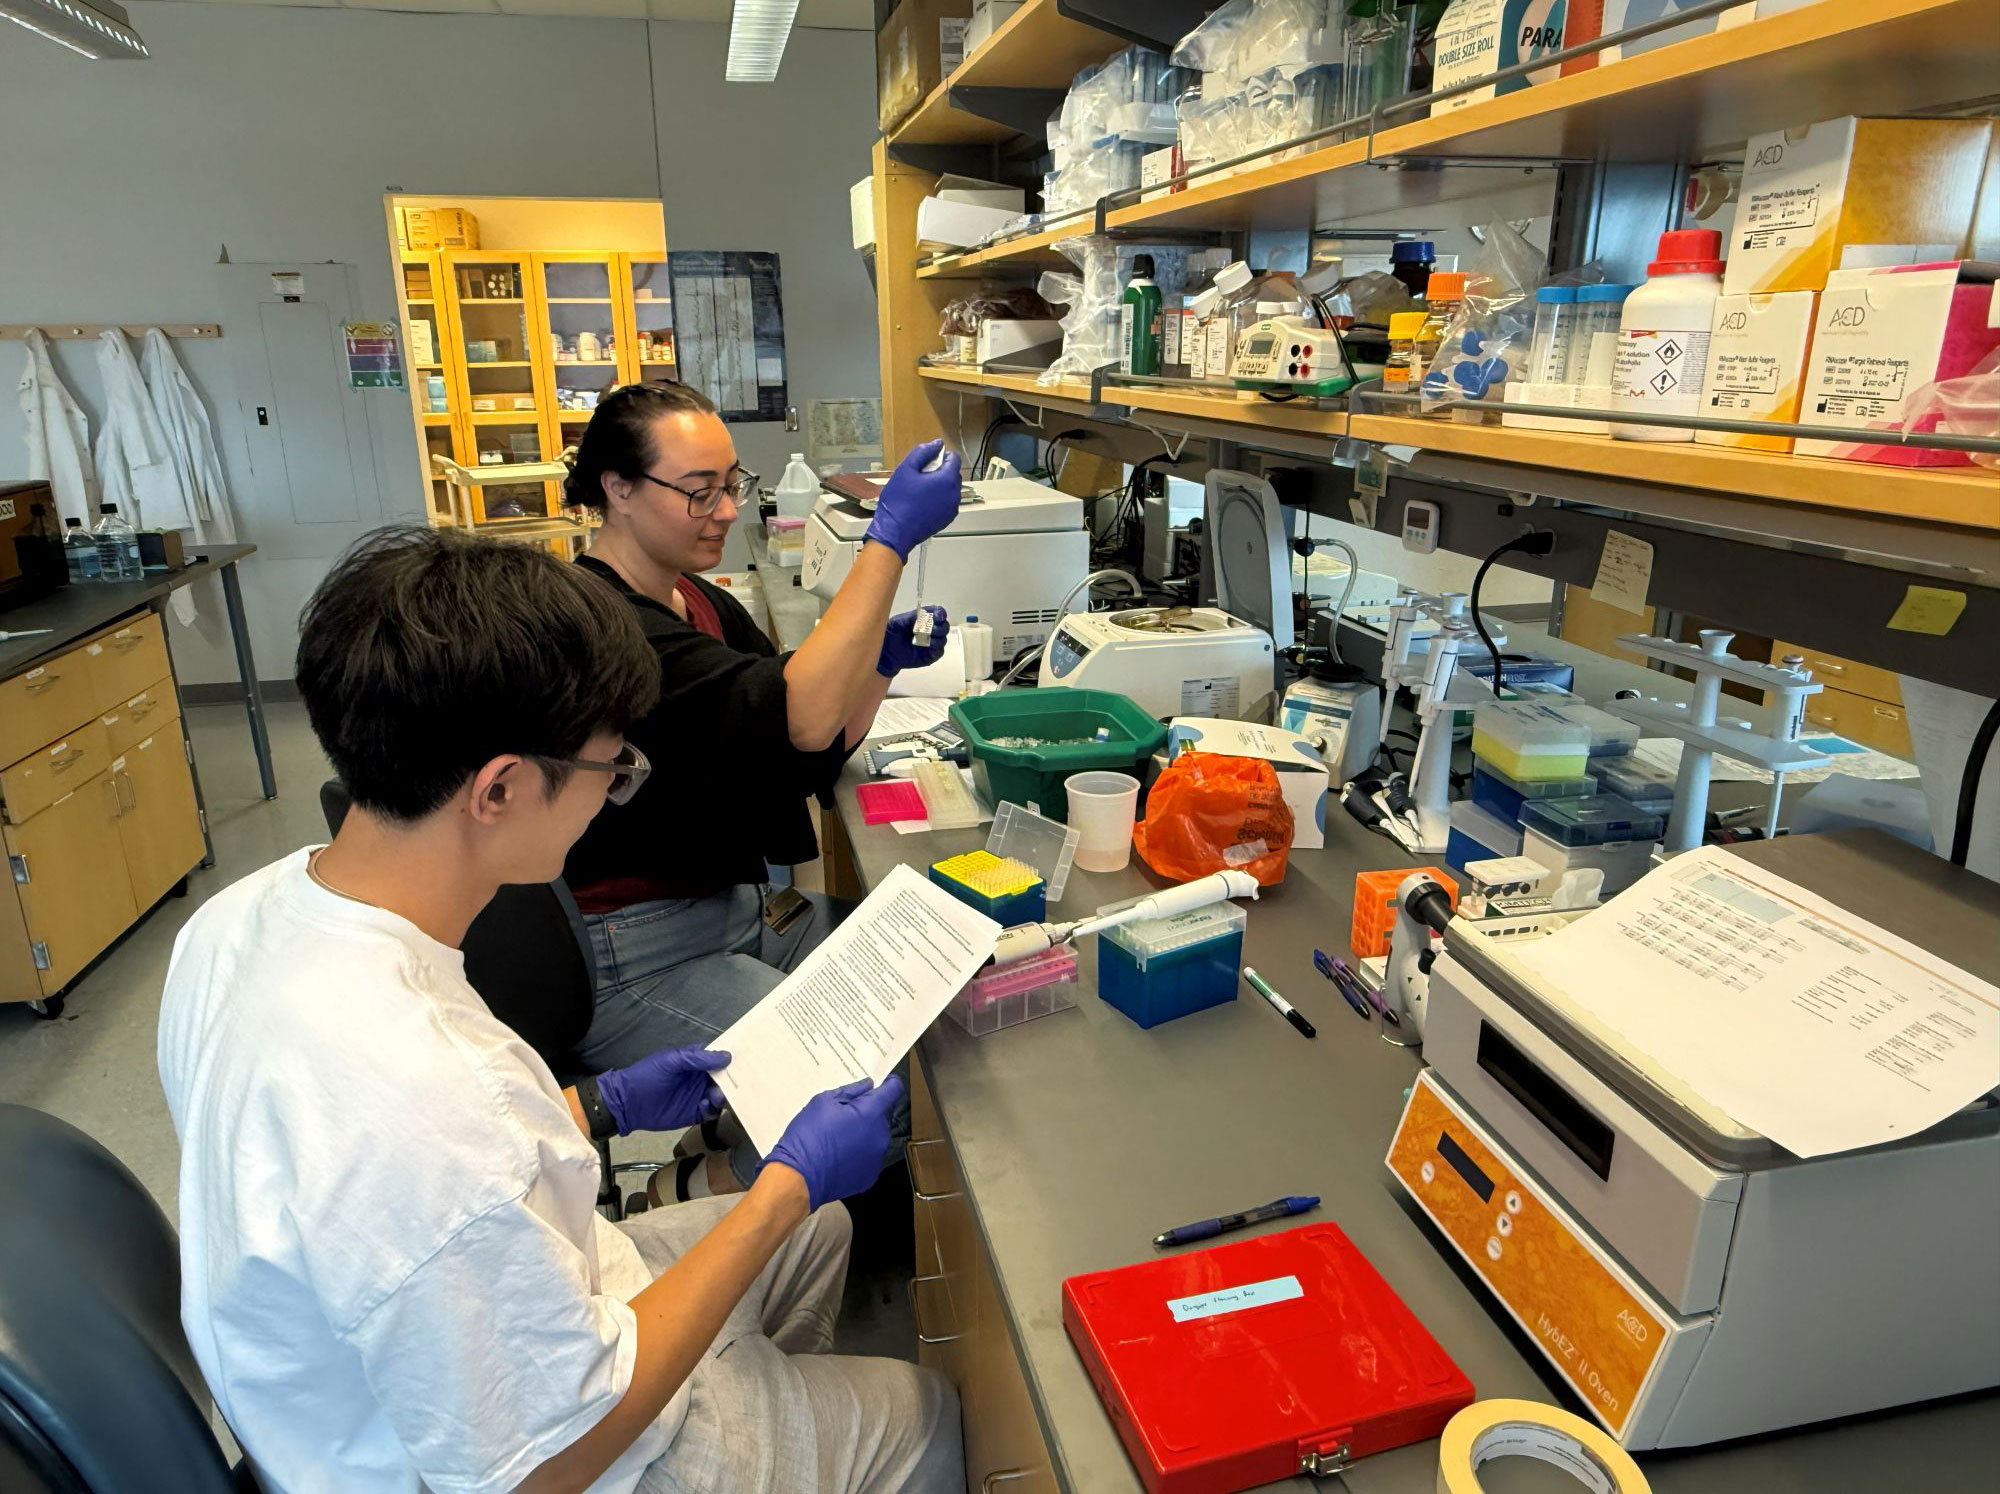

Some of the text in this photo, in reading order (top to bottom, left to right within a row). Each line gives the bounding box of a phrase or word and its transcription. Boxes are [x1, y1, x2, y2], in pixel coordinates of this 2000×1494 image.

[1438, 35, 1494, 68] DOUBLE SIZE ROLL
[1753, 144, 1783, 168] ACD
[1720, 312, 1747, 330] ACD
[1829, 306, 1866, 327] ACD
[1588, 1371, 1619, 1412] Oven
